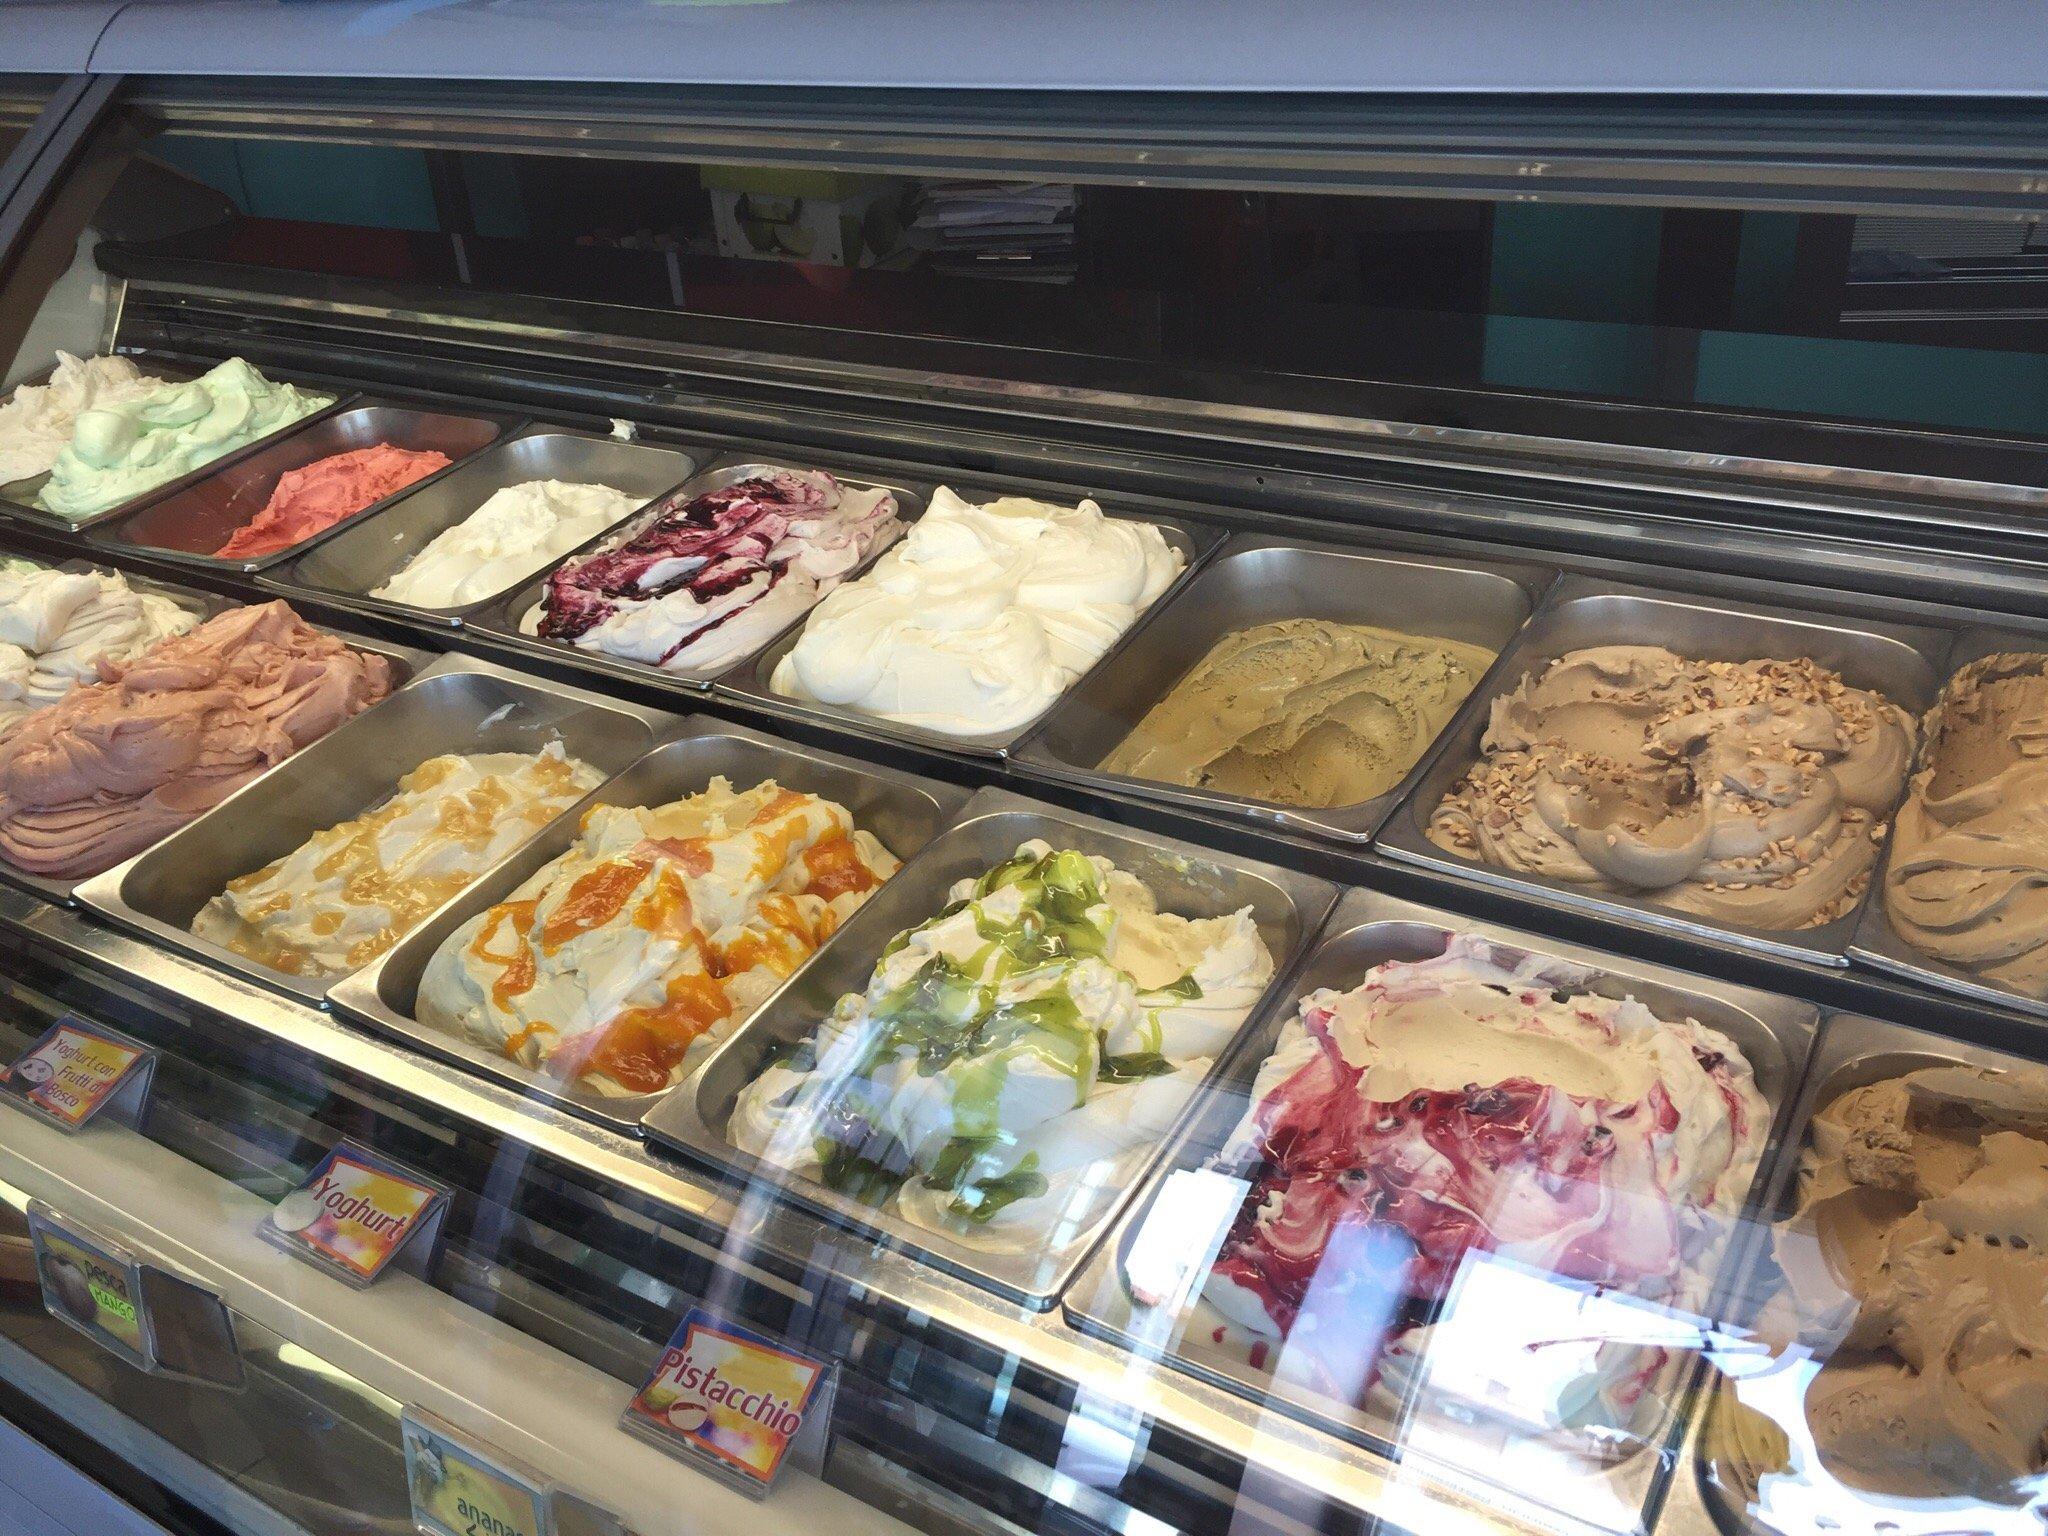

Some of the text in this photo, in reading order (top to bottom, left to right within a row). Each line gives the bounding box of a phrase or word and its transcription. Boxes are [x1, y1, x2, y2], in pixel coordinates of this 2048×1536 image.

[52, 1039, 116, 1077] Yoghurt con
[57, 1065, 92, 1088] Frutti
[47, 1083, 80, 1107] Bosco
[313, 1177, 407, 1240] Yoghurt
[84, 1260, 127, 1297] pesca
[94, 1288, 135, 1322] MANGO
[655, 1347, 801, 1436] Pistacchio
[457, 1497, 524, 1536] anana
